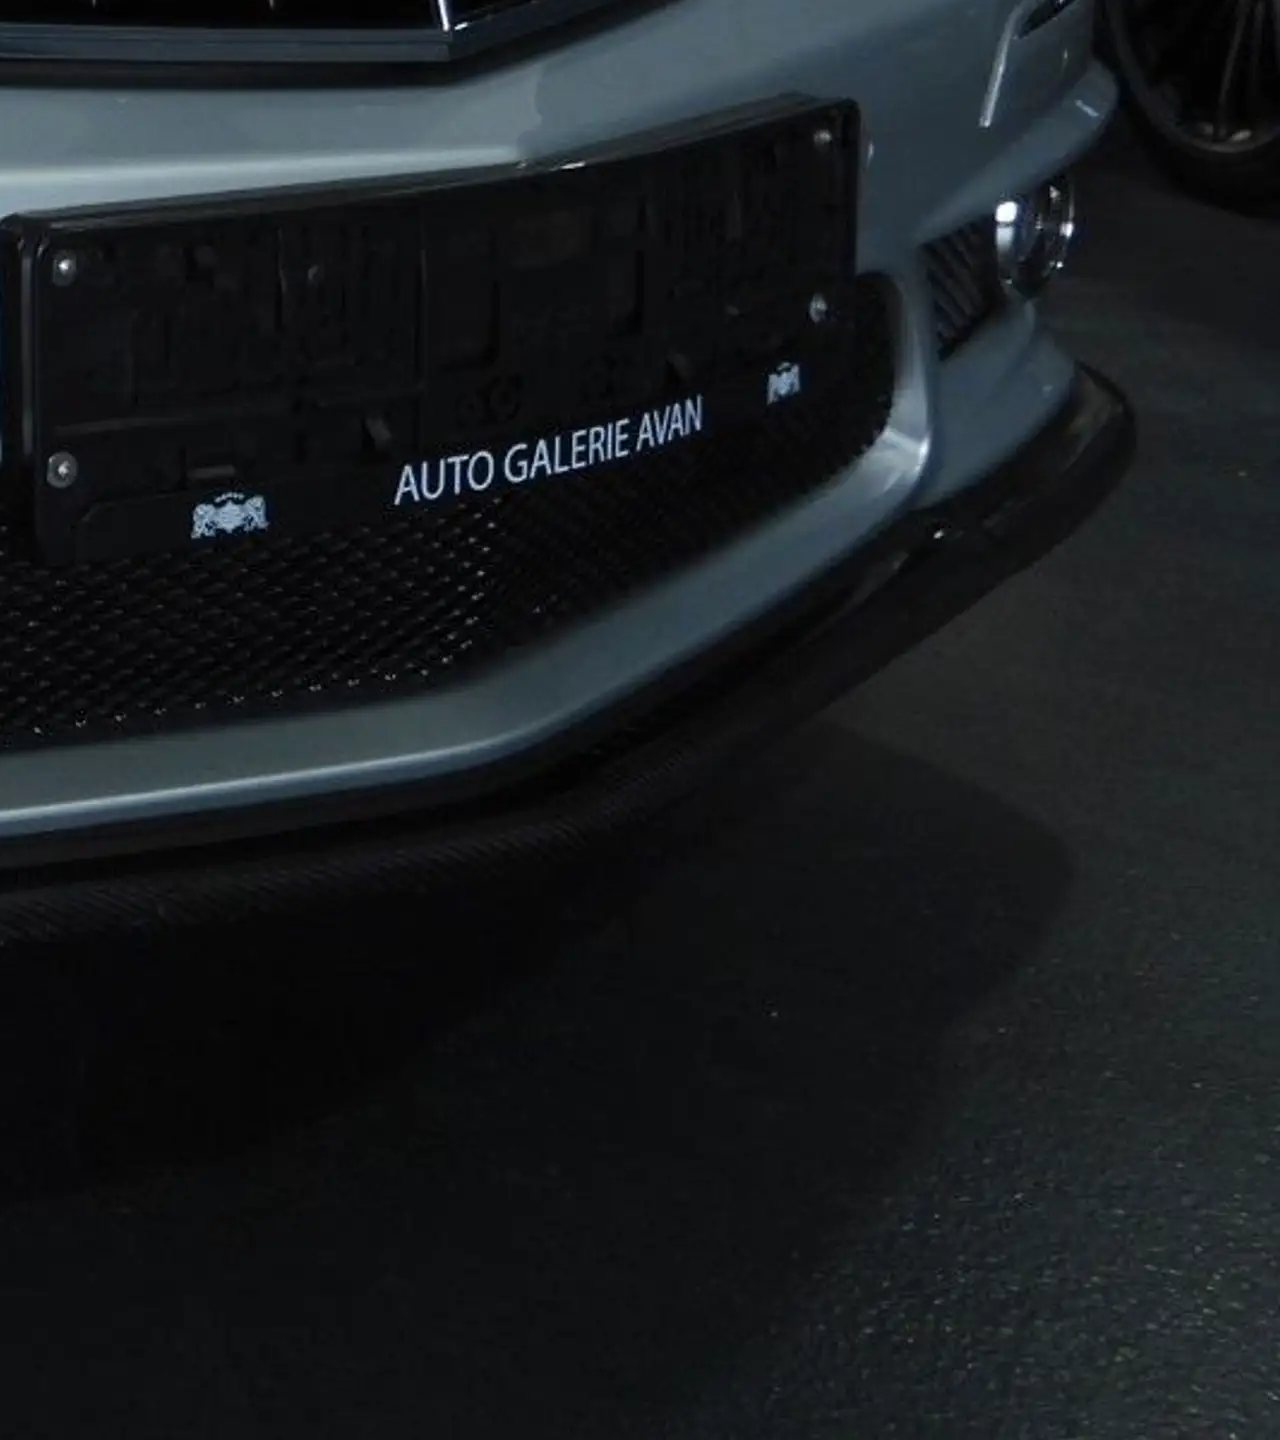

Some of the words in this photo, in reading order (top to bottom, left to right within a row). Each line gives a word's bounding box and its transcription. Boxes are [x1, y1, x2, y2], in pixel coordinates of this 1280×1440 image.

[394, 450, 495, 506] AUTO
[503, 418, 631, 484] GALERIE
[635, 393, 704, 452] AVAN
